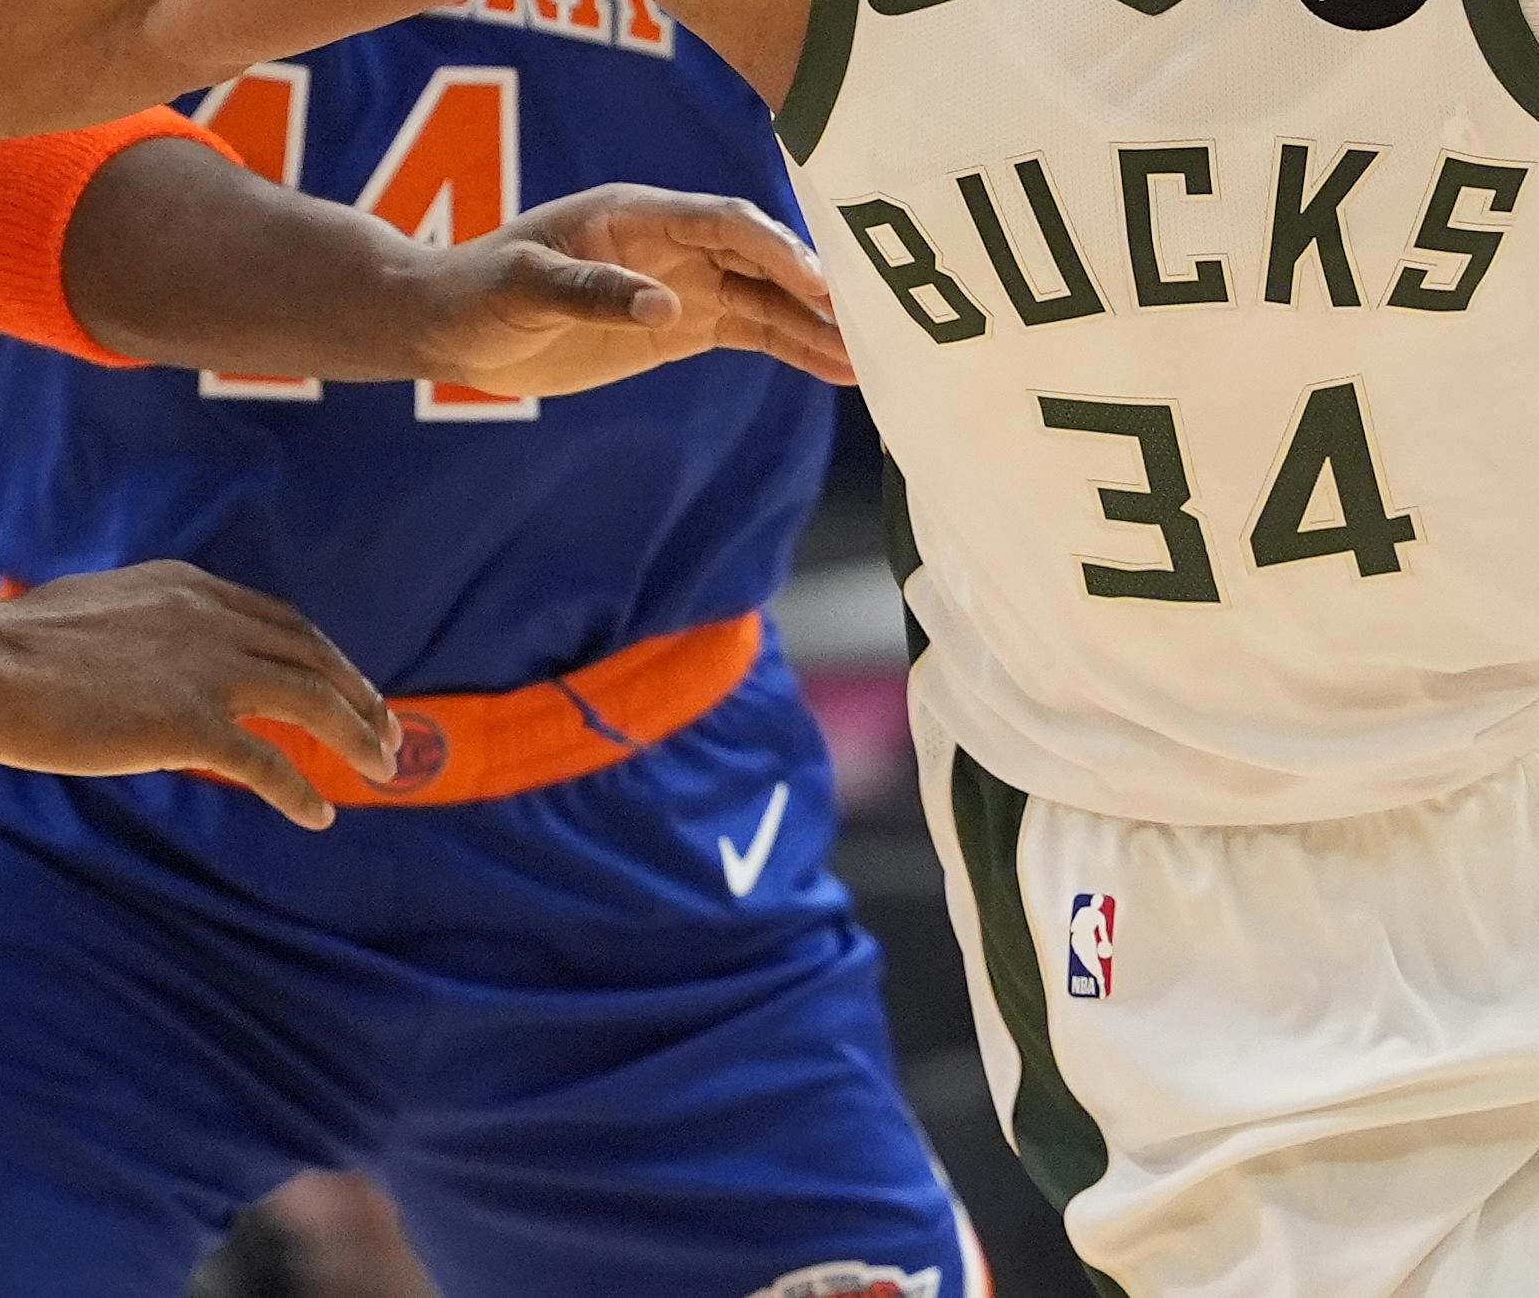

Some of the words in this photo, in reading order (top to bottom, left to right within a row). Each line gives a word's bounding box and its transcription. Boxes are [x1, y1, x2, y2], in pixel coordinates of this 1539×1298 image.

[831, 139, 1534, 346] BUCKS
[1030, 378, 1426, 605] 34
[1071, 974, 1098, 996] NBA
